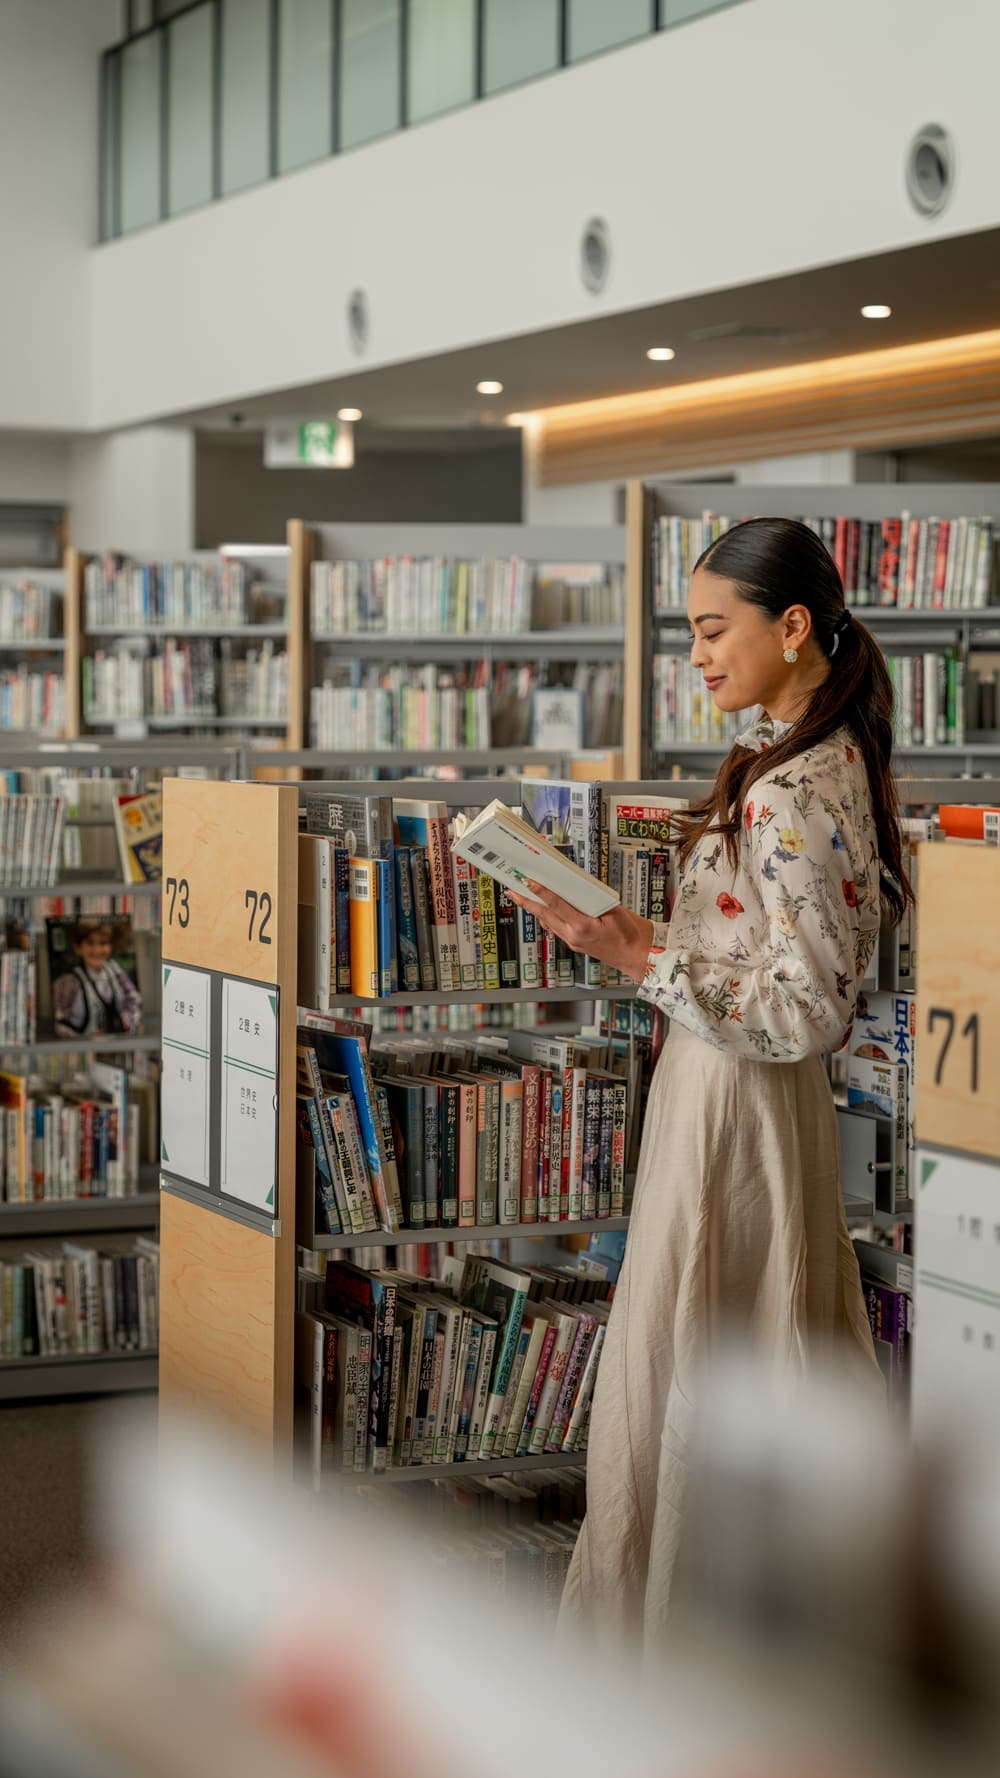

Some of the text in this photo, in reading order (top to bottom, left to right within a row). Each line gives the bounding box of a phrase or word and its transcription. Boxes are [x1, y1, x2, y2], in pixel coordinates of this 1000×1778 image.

[617, 819, 670, 839] 見てわかる
[166, 877, 190, 928] 73
[246, 890, 272, 945] 72
[457, 881, 471, 917] 世界史
[479, 876, 497, 956] 教養の世界史
[928, 1008, 979, 1094] 71
[524, 1072, 542, 1149] 文明のあけぼの
[587, 1088, 601, 1120] 繁栄
[601, 1087, 615, 1120] 繁栄
[346, 1354, 358, 1396] 忠臣蔵
